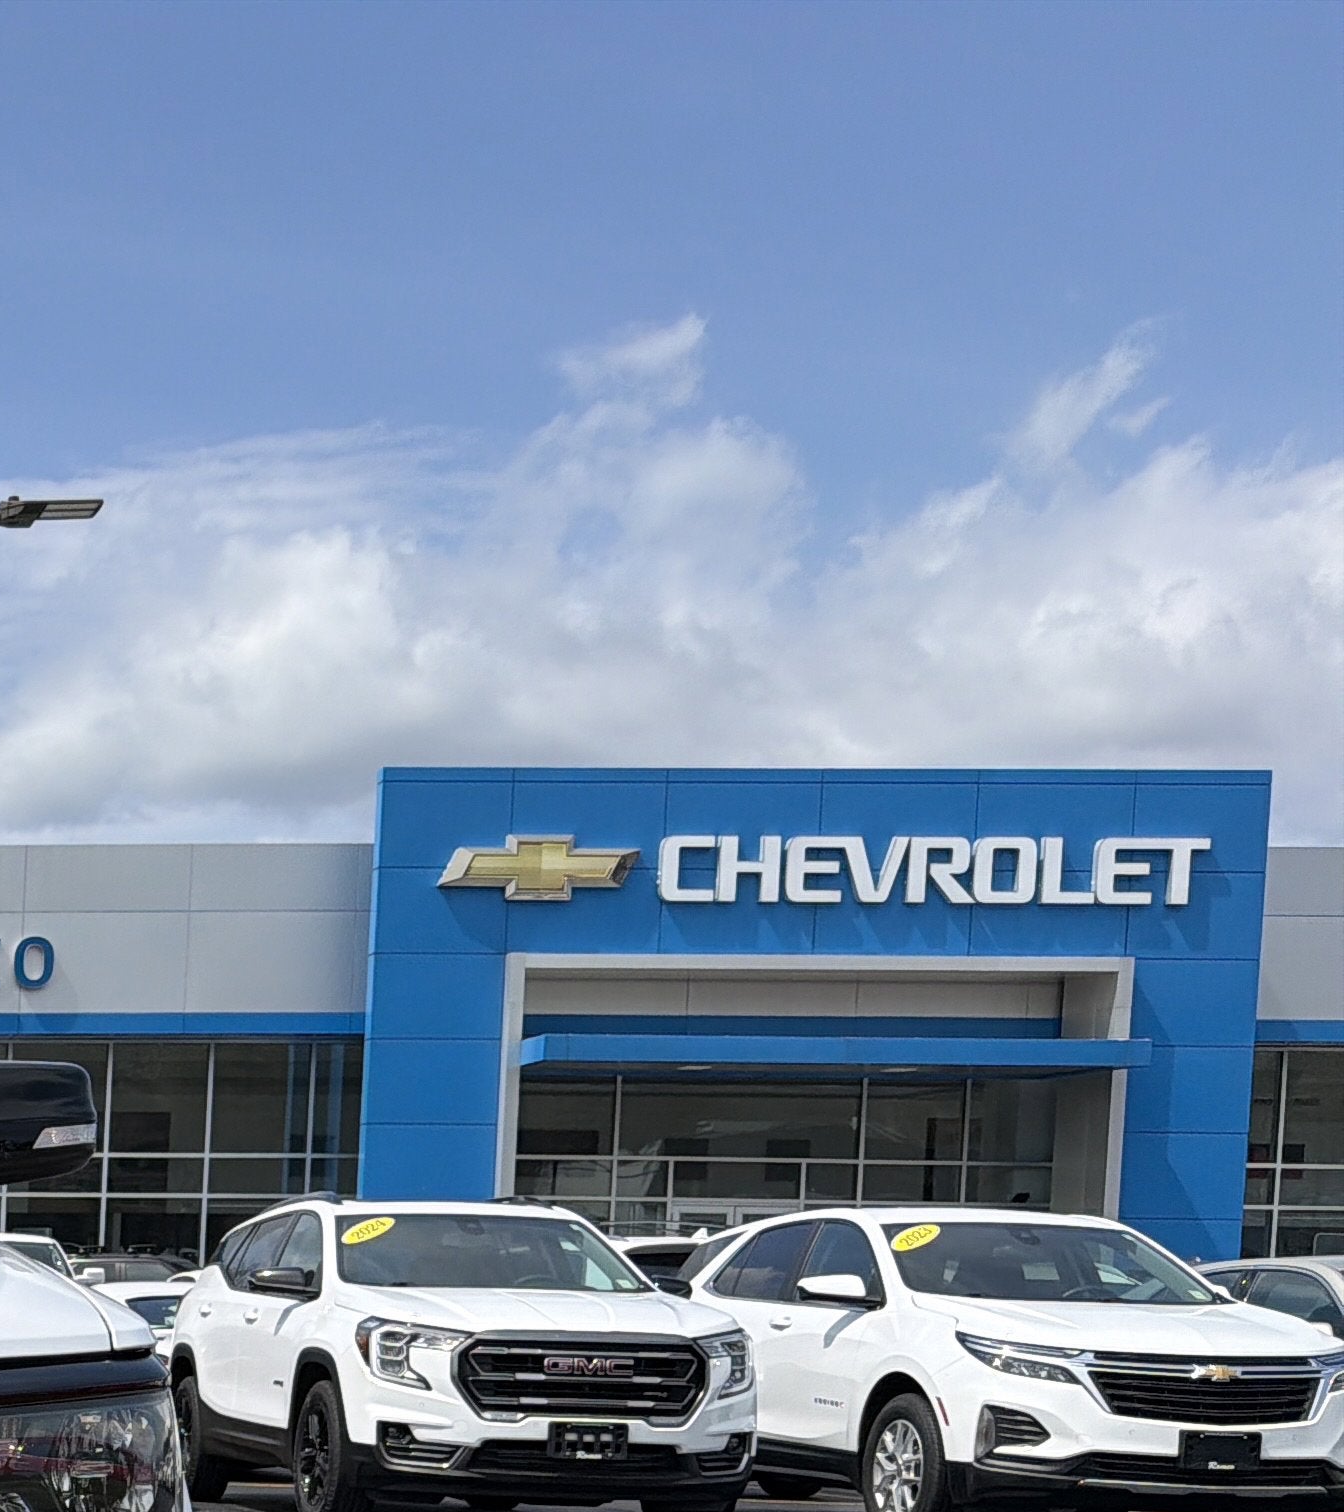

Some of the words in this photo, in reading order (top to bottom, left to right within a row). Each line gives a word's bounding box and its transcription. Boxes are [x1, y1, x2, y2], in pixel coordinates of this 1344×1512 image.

[658, 835, 1212, 906] CHEVROLET
[350, 1219, 387, 1240] 2024
[898, 1226, 933, 1247] 2023
[543, 1356, 635, 1376] GMC
